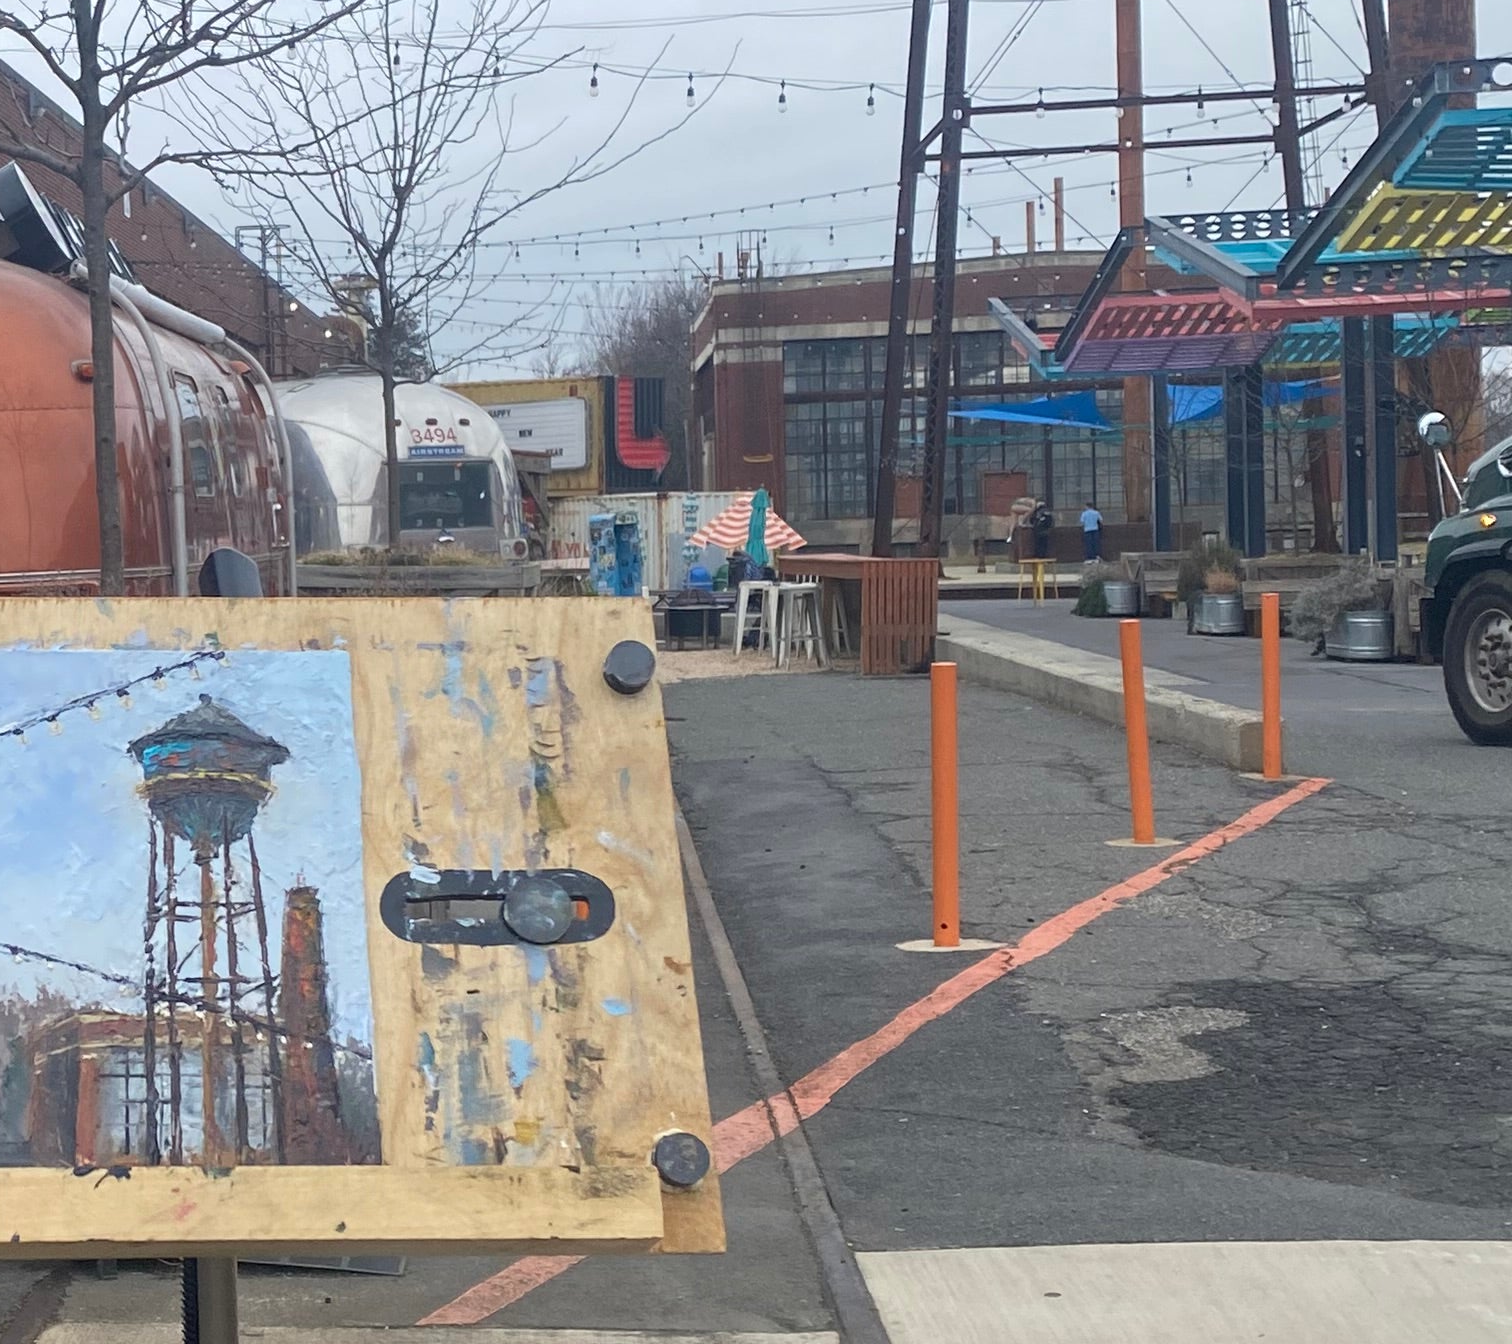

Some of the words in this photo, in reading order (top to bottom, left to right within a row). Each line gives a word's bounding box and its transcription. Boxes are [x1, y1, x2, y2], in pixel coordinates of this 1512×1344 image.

[411, 428, 457, 444] 3494
[519, 429, 533, 438] NEW
[411, 447, 464, 456] AIRSTREAM
